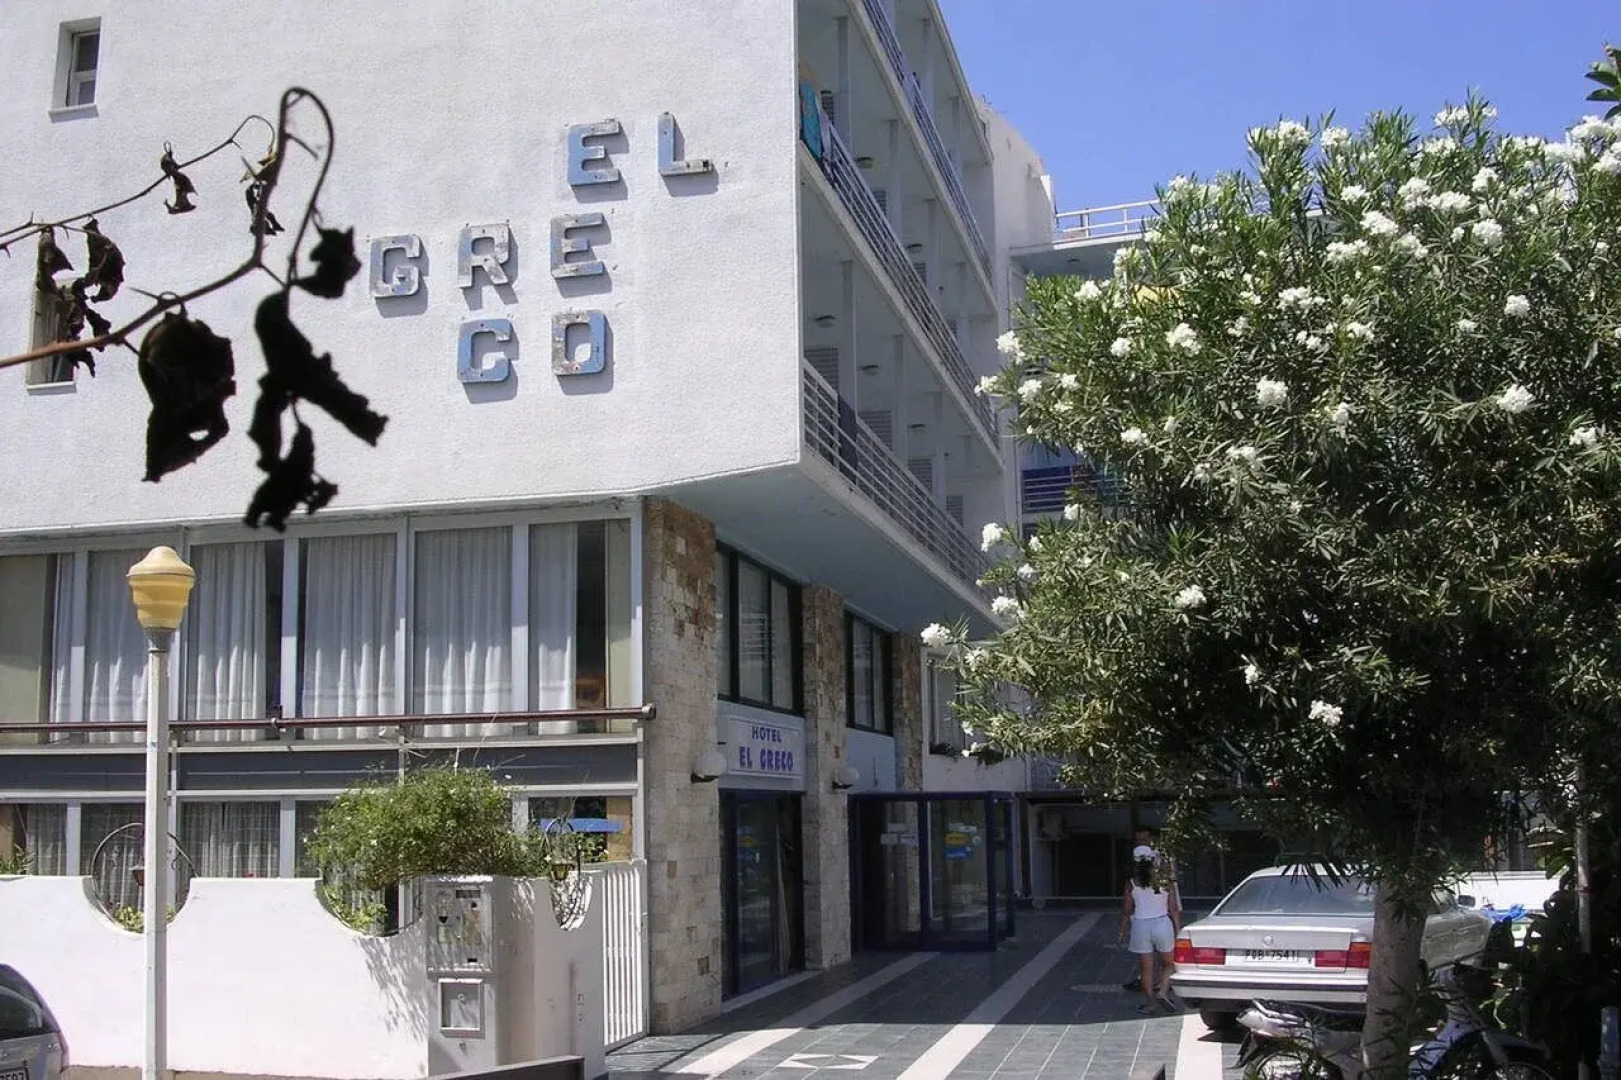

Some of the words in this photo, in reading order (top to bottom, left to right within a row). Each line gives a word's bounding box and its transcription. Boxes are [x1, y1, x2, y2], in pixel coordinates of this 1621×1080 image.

[568, 112, 714, 186] EL
[370, 213, 604, 297] GRE
[457, 310, 606, 383] CO
[739, 746, 753, 768] EL
[760, 748, 794, 771] GRECO
[752, 725, 782, 742] HOTEL
